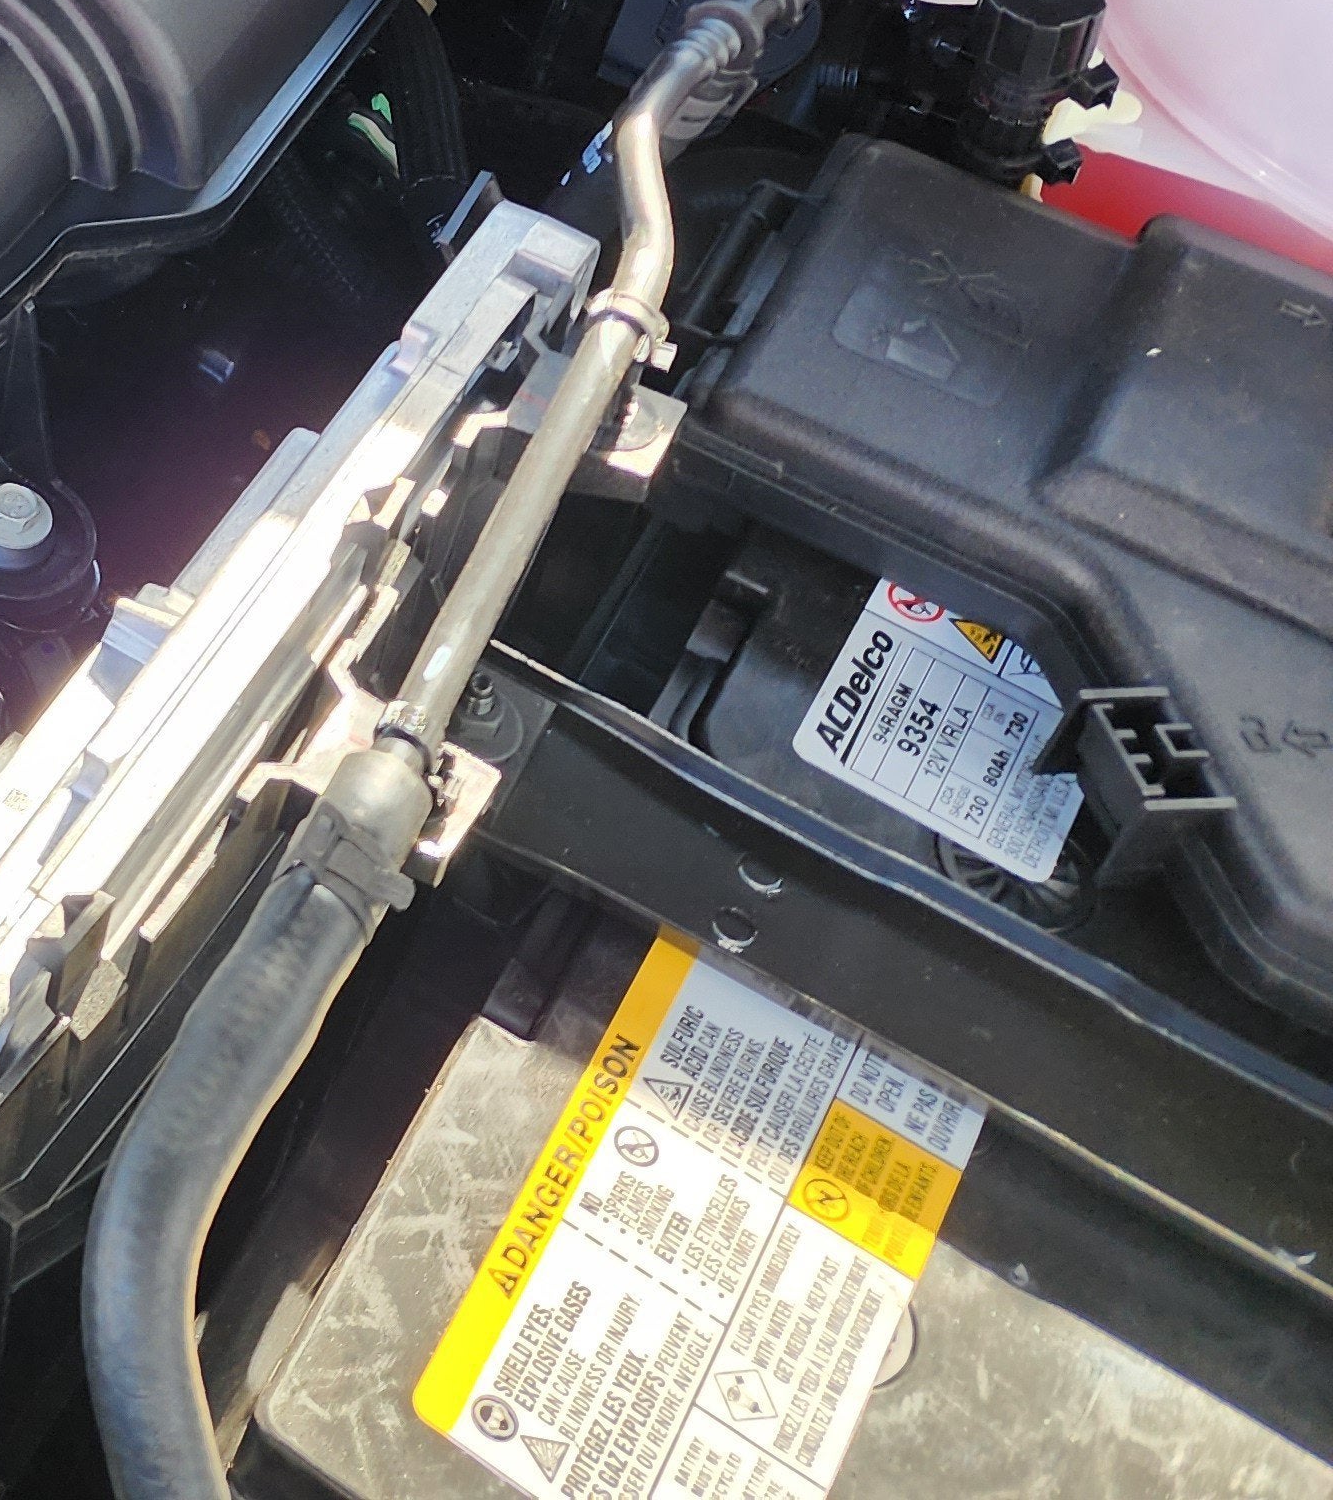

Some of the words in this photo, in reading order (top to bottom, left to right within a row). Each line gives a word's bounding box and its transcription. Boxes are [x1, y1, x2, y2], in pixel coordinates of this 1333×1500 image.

[814, 629, 895, 756] ACDelco
[871, 680, 914, 747] 94RAGM
[895, 694, 942, 759] 9354
[921, 747, 950, 781] 12V
[936, 701, 973, 752] VRLA
[1003, 708, 1030, 743] 730
[980, 745, 1012, 788] 80Ah
[963, 792, 990, 827] 730
[1020, 819, 1055, 868] DETROIT
[658, 1000, 706, 1070] SULFURIC
[680, 1044, 710, 1082] ACID
[697, 1019, 723, 1050] CAN
[681, 1088, 715, 1134] CAUSE
[700, 1024, 747, 1095] BLINDNESS
[783, 1070, 806, 1095] LA
[847, 1079, 873, 1106] DO
[856, 1050, 887, 1087] NOT
[710, 1075, 747, 1127] SEVERE
[720, 1105, 761, 1161] L'ACIDE
[741, 1034, 796, 1116] SULFURIQUE
[759, 1088, 799, 1143] CAUSER
[902, 1109, 928, 1136] NE
[910, 1085, 939, 1118] PAS
[500, 1030, 640, 1273] DANGER/POISON
[701, 1120, 725, 1146] OR
[745, 1135, 776, 1174] PEUT
[775, 1135, 802, 1167] DES
[601, 1168, 638, 1220] SPARKS
[766, 1160, 790, 1186] OU
[577, 1189, 604, 1217] NO
[618, 1178, 655, 1230] FLAMES
[634, 1182, 676, 1242] SMOKING
[709, 1194, 752, 1257] FLAMMES
[647, 1205, 693, 1265] ÉVITER
[680, 1240, 706, 1270] LES
[724, 1226, 760, 1276] FUMER
[756, 1221, 804, 1294] IMMEDIATELY
[698, 1252, 724, 1282] LES
[716, 1269, 739, 1294] DE
[603, 1289, 644, 1346] INJURY.
[745, 1288, 772, 1321] EYES
[801, 1279, 831, 1315] HELP
[491, 1339, 534, 1399] SHIELD
[518, 1297, 556, 1347] EYES.
[512, 1326, 569, 1413] EXPLOSIVE
[552, 1278, 593, 1334] GASES
[594, 1340, 618, 1367] OR
[651, 1310, 696, 1376] PEUVENT
[668, 1323, 716, 1393] AVEUGLE.
[728, 1314, 761, 1357] FLUSH
[749, 1335, 778, 1371] WITH
[780, 1307, 819, 1362] MEDICAL
[535, 1392, 565, 1427] CAN
[550, 1347, 587, 1398] CAUSE
[610, 1343, 650, 1396] YEUX.
[770, 1355, 797, 1386] GET
[795, 1366, 823, 1399] YEUX
[556, 1361, 609, 1441] BLINDNESS
[596, 1389, 628, 1426] LES
[610, 1368, 669, 1457] EXPLOSIFS
[643, 1387, 686, 1448] RENDRE
[787, 1393, 811, 1418] LES
[770, 1412, 803, 1454] RINCEZ
[791, 1406, 835, 1469] CONSULTEZ
[818, 1390, 840, 1413] UN
[596, 1449, 630, 1490] GAZ
[634, 1442, 660, 1471] OU
[672, 1435, 708, 1488] BATTERY
